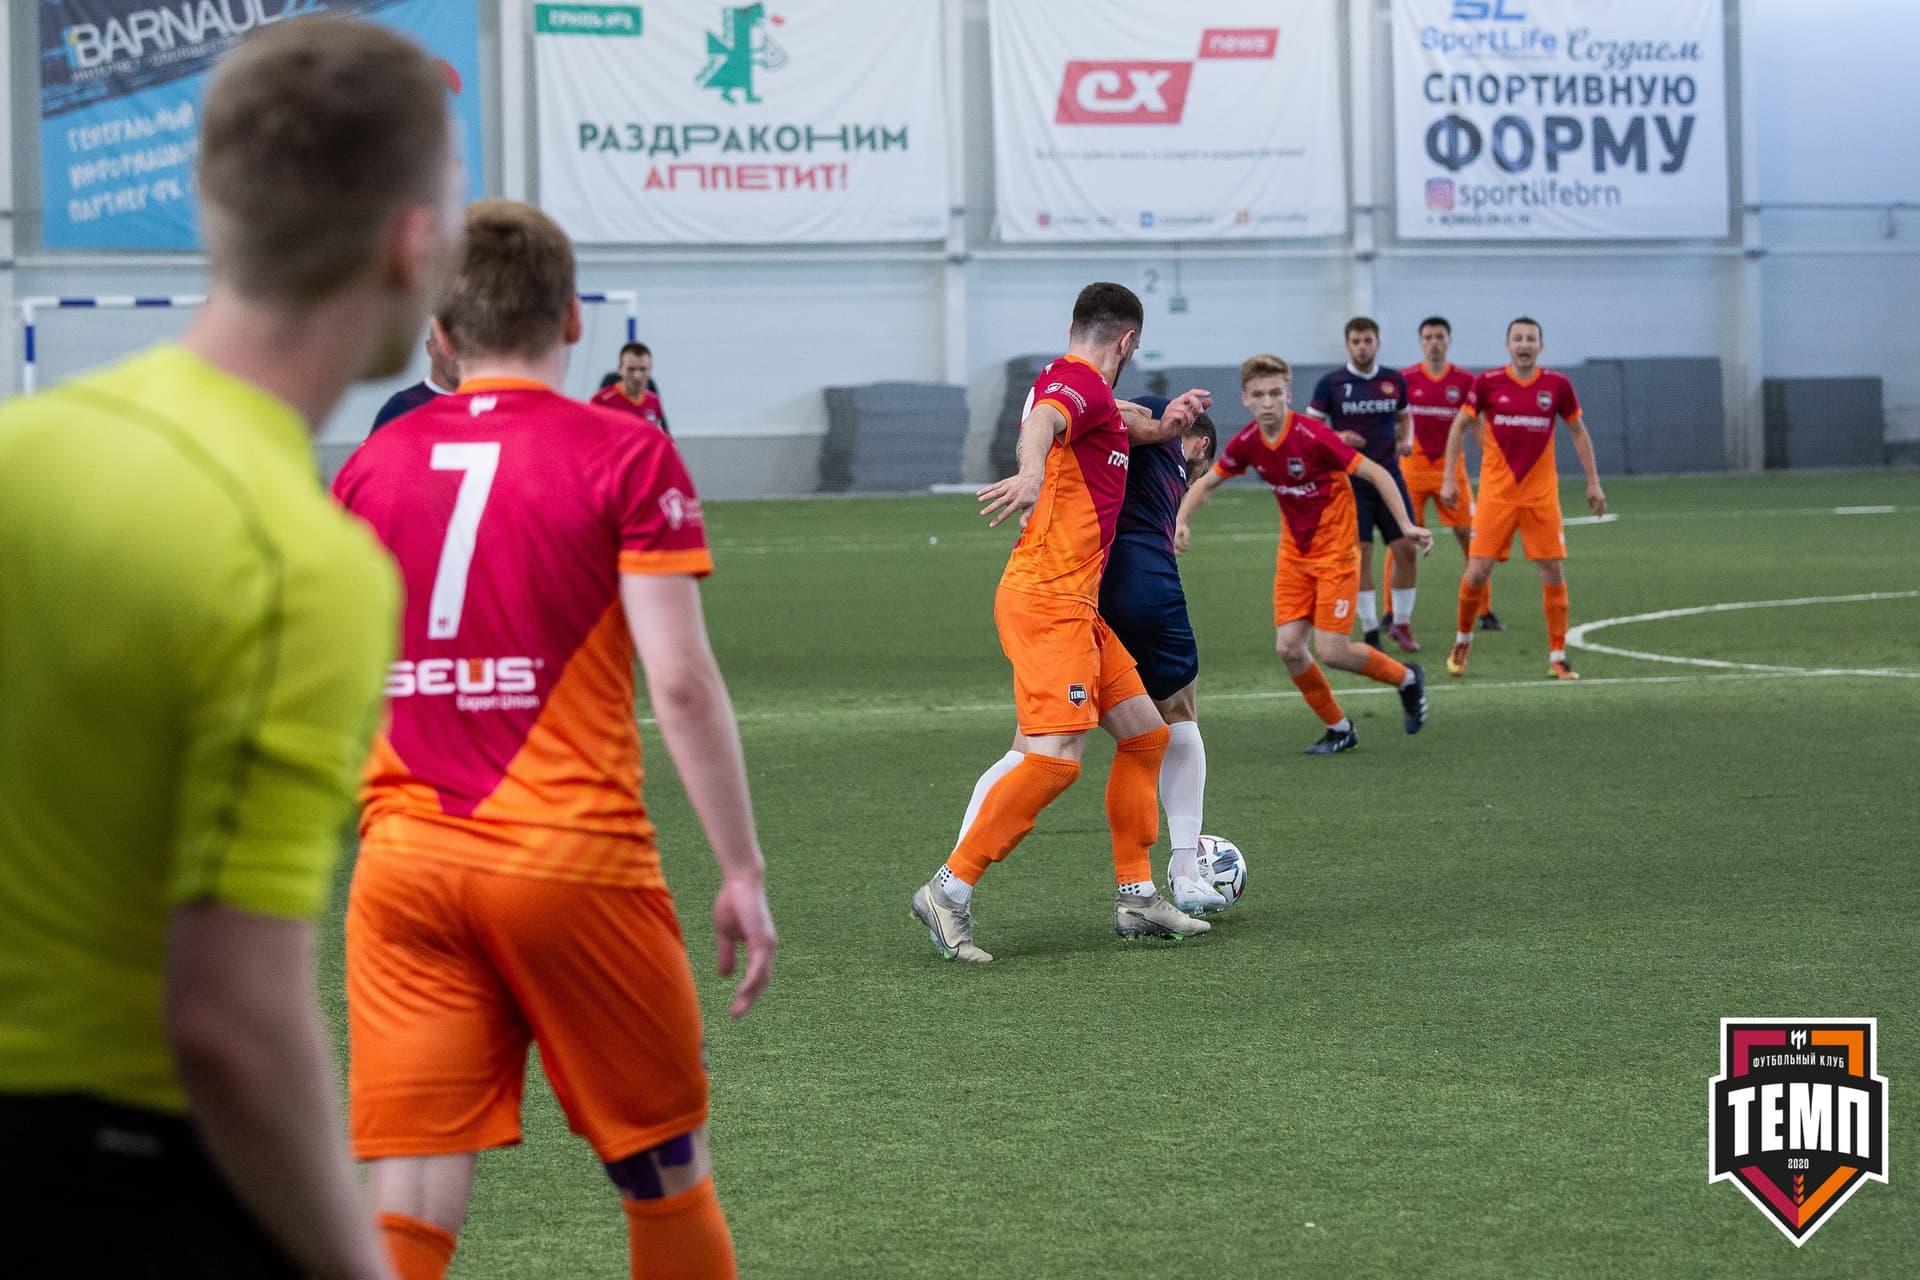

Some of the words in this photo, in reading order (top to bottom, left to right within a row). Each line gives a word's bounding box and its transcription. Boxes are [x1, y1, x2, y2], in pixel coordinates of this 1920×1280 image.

[1424, 71, 1697, 106] СПОРТИВНУЮ
[578, 123, 908, 157] РАЗДРАКОНИМ
[1425, 114, 1696, 173] ФОРМУ
[644, 163, 849, 191] АППЕТИТ!
[1458, 178, 1622, 210] sportlifebrn
[1144, 267, 1160, 294] 2
[427, 442, 501, 640] 7
